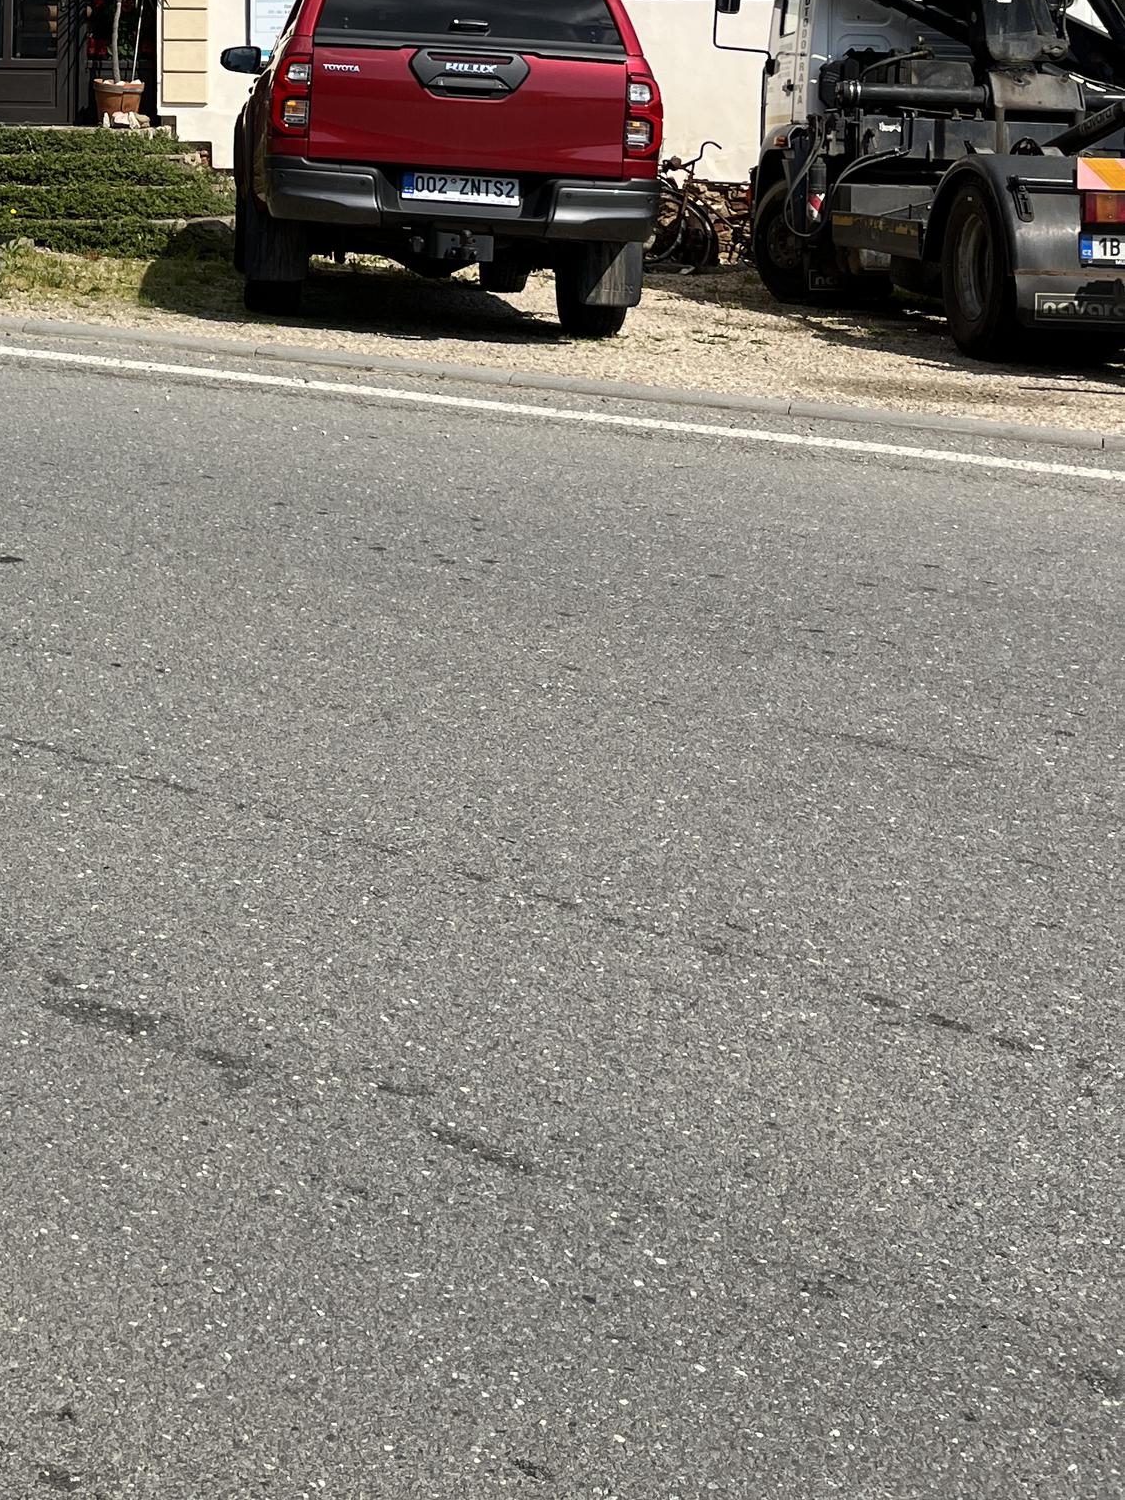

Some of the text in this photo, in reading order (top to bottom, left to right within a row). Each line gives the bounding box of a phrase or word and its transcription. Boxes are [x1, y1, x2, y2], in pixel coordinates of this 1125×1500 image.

[322, 63, 361, 73] TOYOTA
[445, 62, 498, 74] HILUX
[459, 177, 516, 199] ZNTS2
